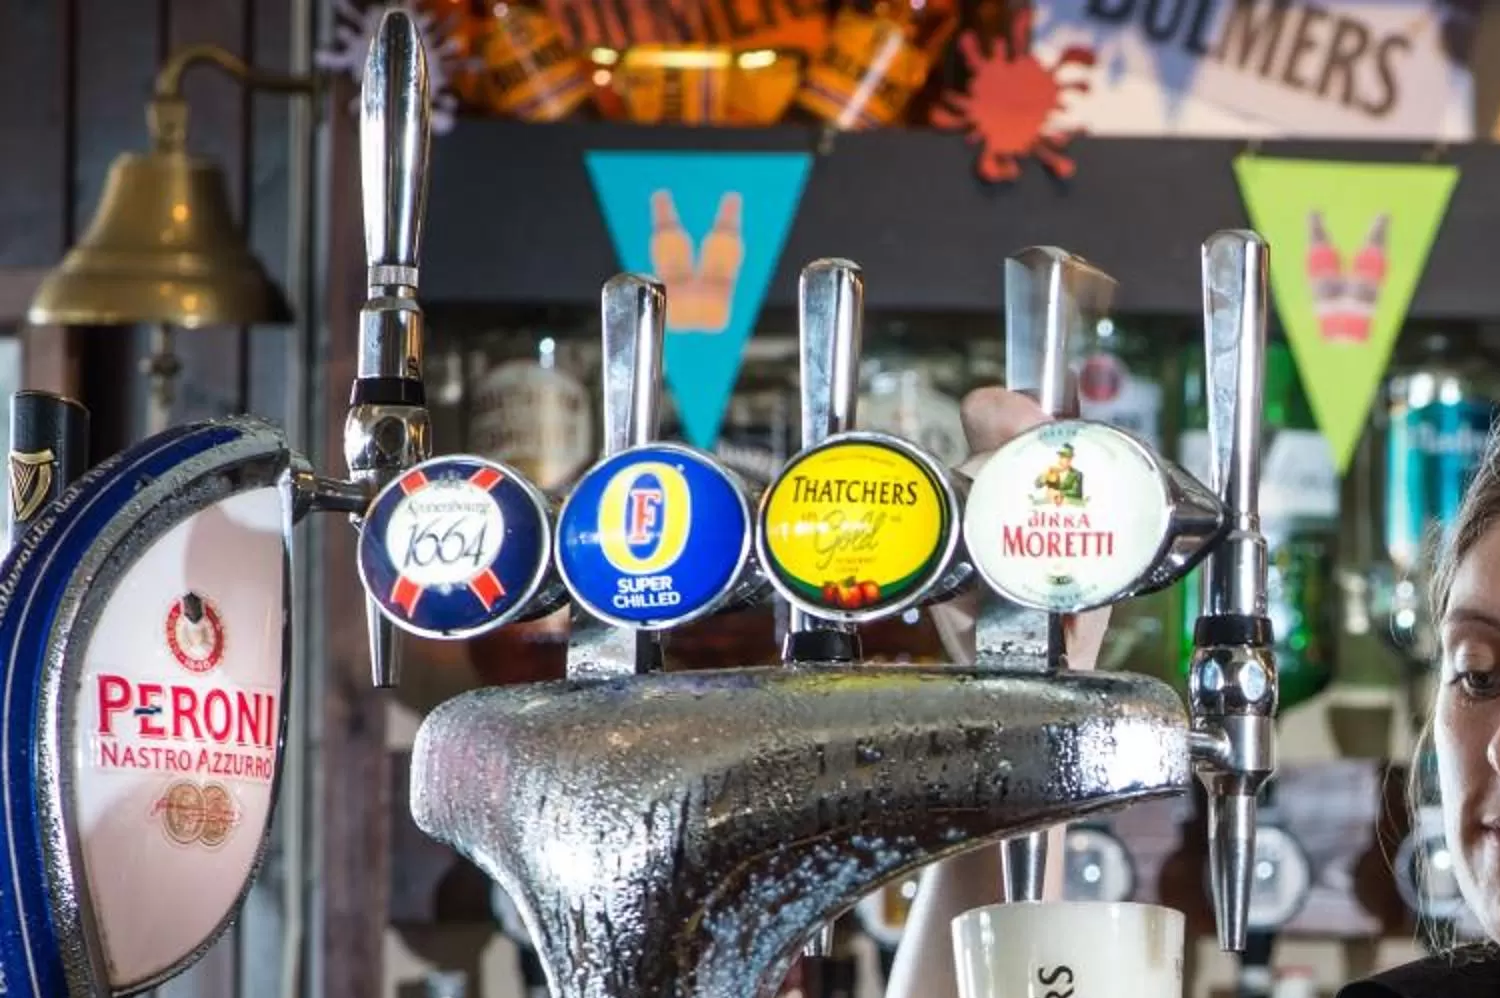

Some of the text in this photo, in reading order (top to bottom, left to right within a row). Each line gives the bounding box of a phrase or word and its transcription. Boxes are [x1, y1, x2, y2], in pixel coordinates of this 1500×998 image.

[1084, 0, 1414, 119] ULMERS
[793, 475, 918, 506] THATCHERS
[629, 489, 661, 545] F
[403, 515, 488, 568] 1664
[814, 509, 887, 571] Gold
[1002, 524, 1114, 557] MORETTI
[613, 592, 681, 609] CHILLED
[617, 576, 673, 594] SUPER
[97, 674, 274, 747] PERONI
[101, 743, 272, 779] NASTRO AZZURRO
